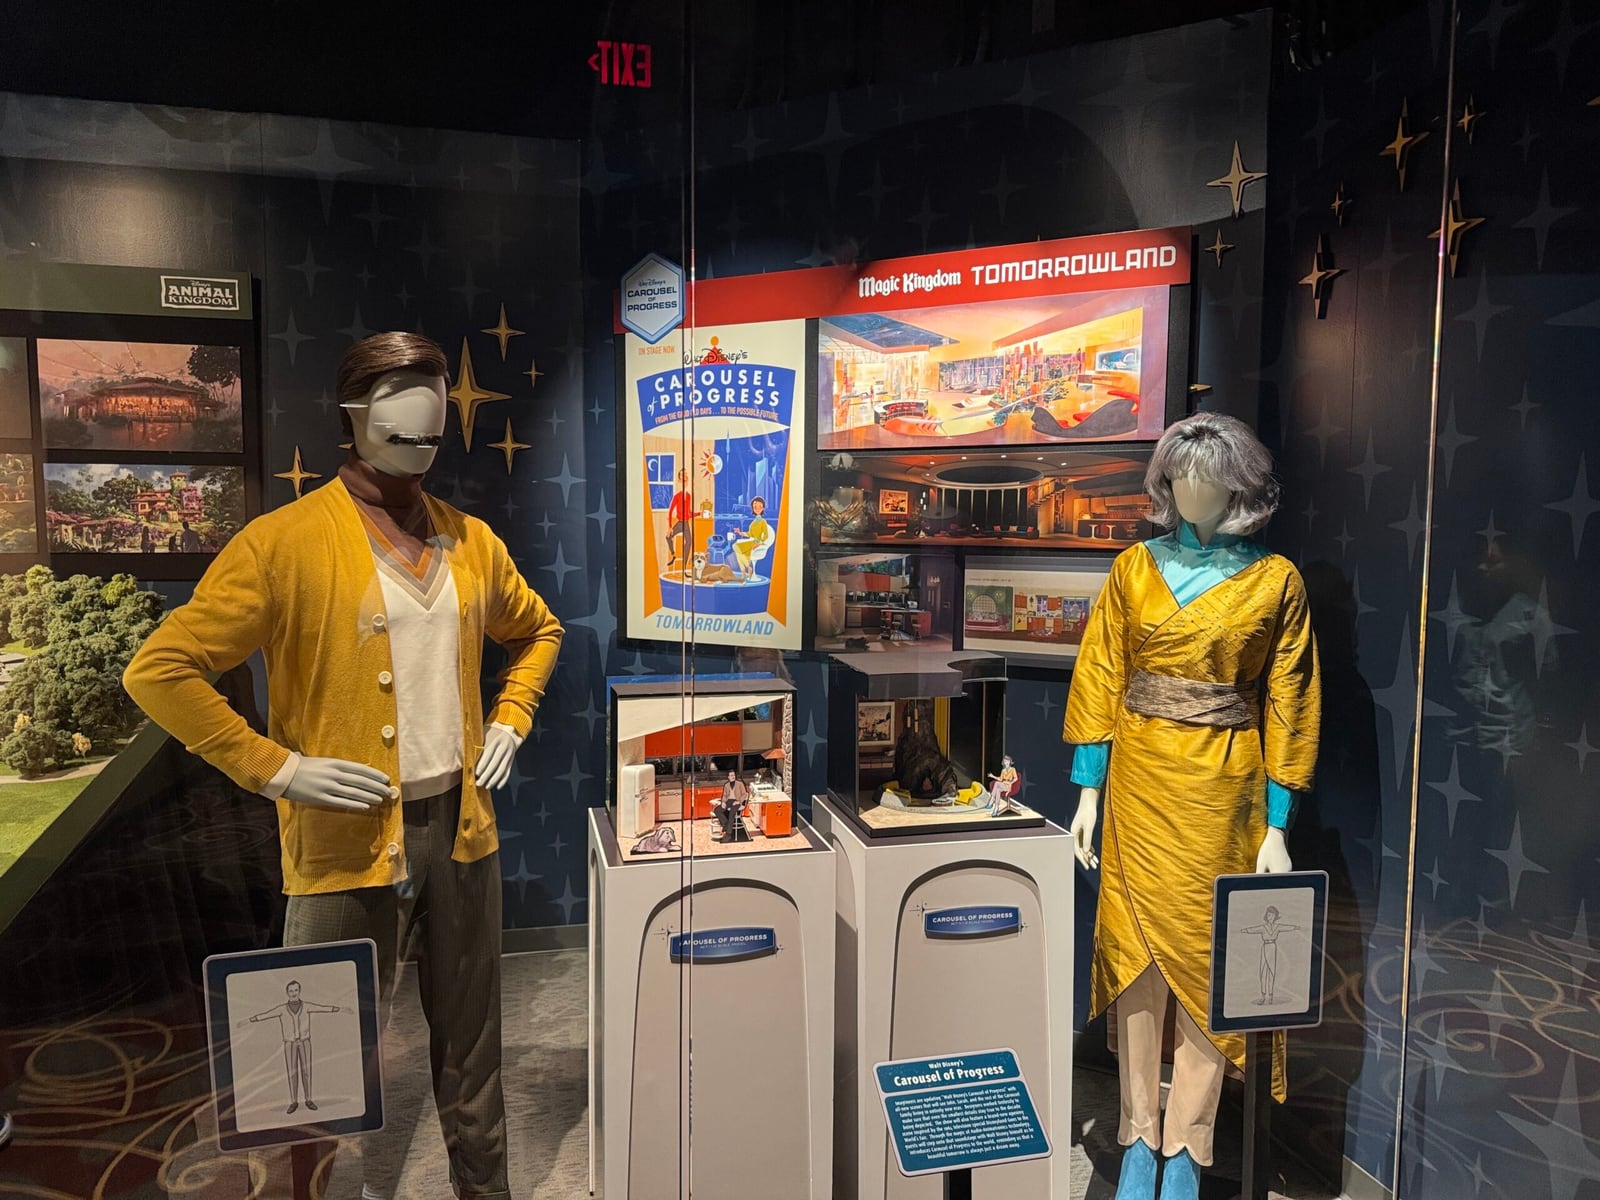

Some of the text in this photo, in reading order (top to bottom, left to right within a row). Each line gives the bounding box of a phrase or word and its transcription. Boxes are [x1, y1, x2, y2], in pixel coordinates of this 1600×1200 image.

[858, 245, 1177, 298] Magic Kingdom TOMORROWLAND
[168, 286, 233, 298] ANIMAL
[627, 286, 677, 298] CAROUSEL
[168, 296, 233, 306] KINGDOM
[627, 300, 678, 312] PROGRESS
[646, 347, 662, 355] STAGE
[663, 346, 675, 354] NOW
[654, 368, 775, 392] CAROUSEL
[647, 388, 780, 416] of PROGRESS
[668, 412, 676, 420] THE
[720, 406, 726, 414] TO
[727, 406, 736, 414] THE
[736, 406, 760, 416] POSSIBLE
[656, 614, 774, 636] TOMORROWLAND
[932, 916, 967, 924] CAROUSEL
[978, 912, 1013, 920] PROGRESS
[730, 934, 768, 942] PROGRESS
[928, 1060, 964, 1070] Walt Disney's
[894, 1065, 1005, 1086] Carousel of Progress
